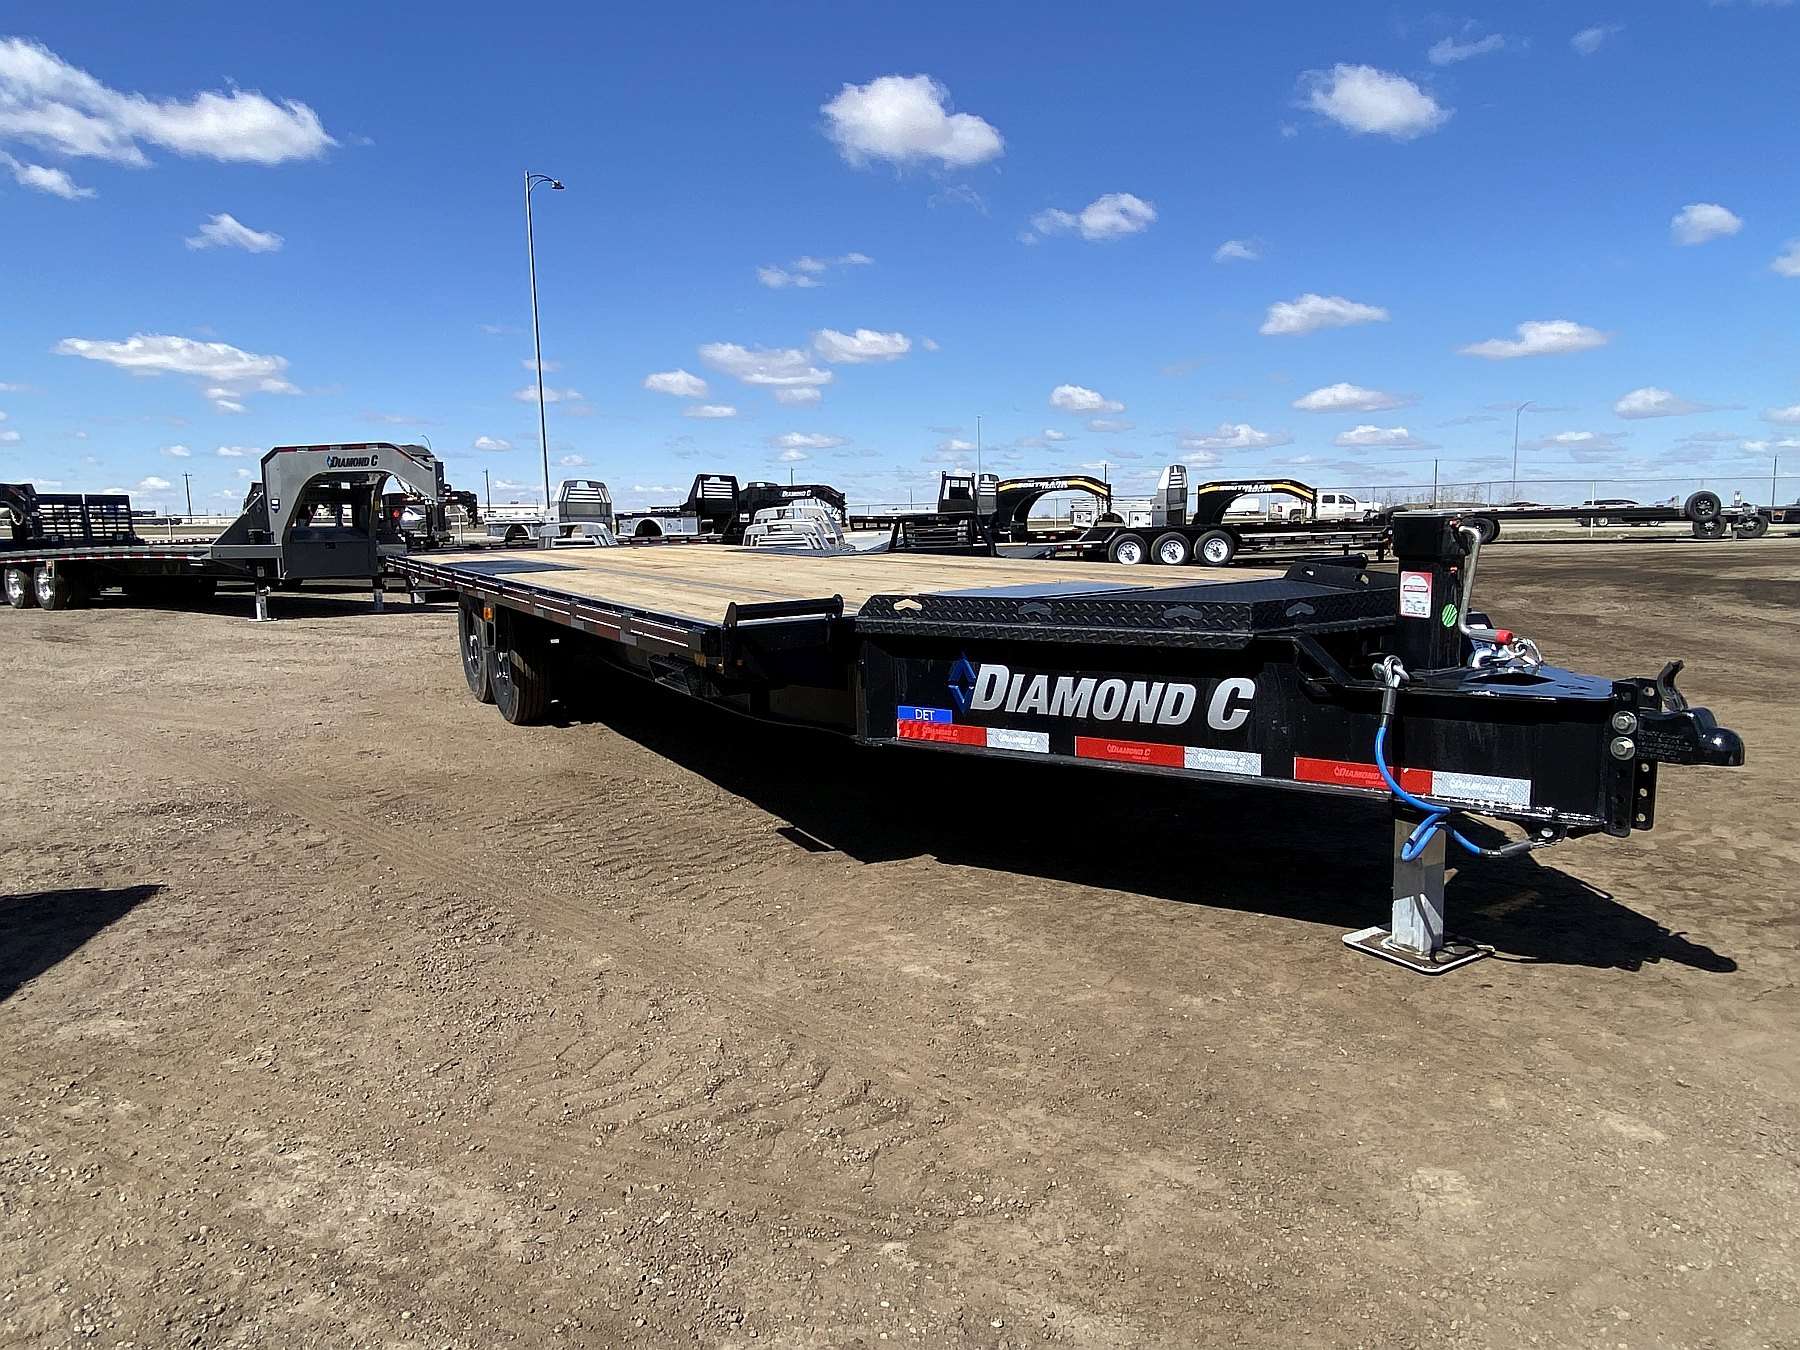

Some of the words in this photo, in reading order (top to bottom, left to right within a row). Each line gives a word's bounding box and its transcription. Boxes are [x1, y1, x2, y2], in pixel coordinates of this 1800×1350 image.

[331, 456, 369, 467] DIAMOND
[371, 455, 378, 467] C
[970, 664, 1197, 726] DIAMOND
[1207, 677, 1256, 731] C
[915, 708, 935, 721] DET
[1111, 744, 1144, 756] DIAMOND
[1144, 748, 1151, 757] C
[1340, 767, 1381, 780] DIAMOND
